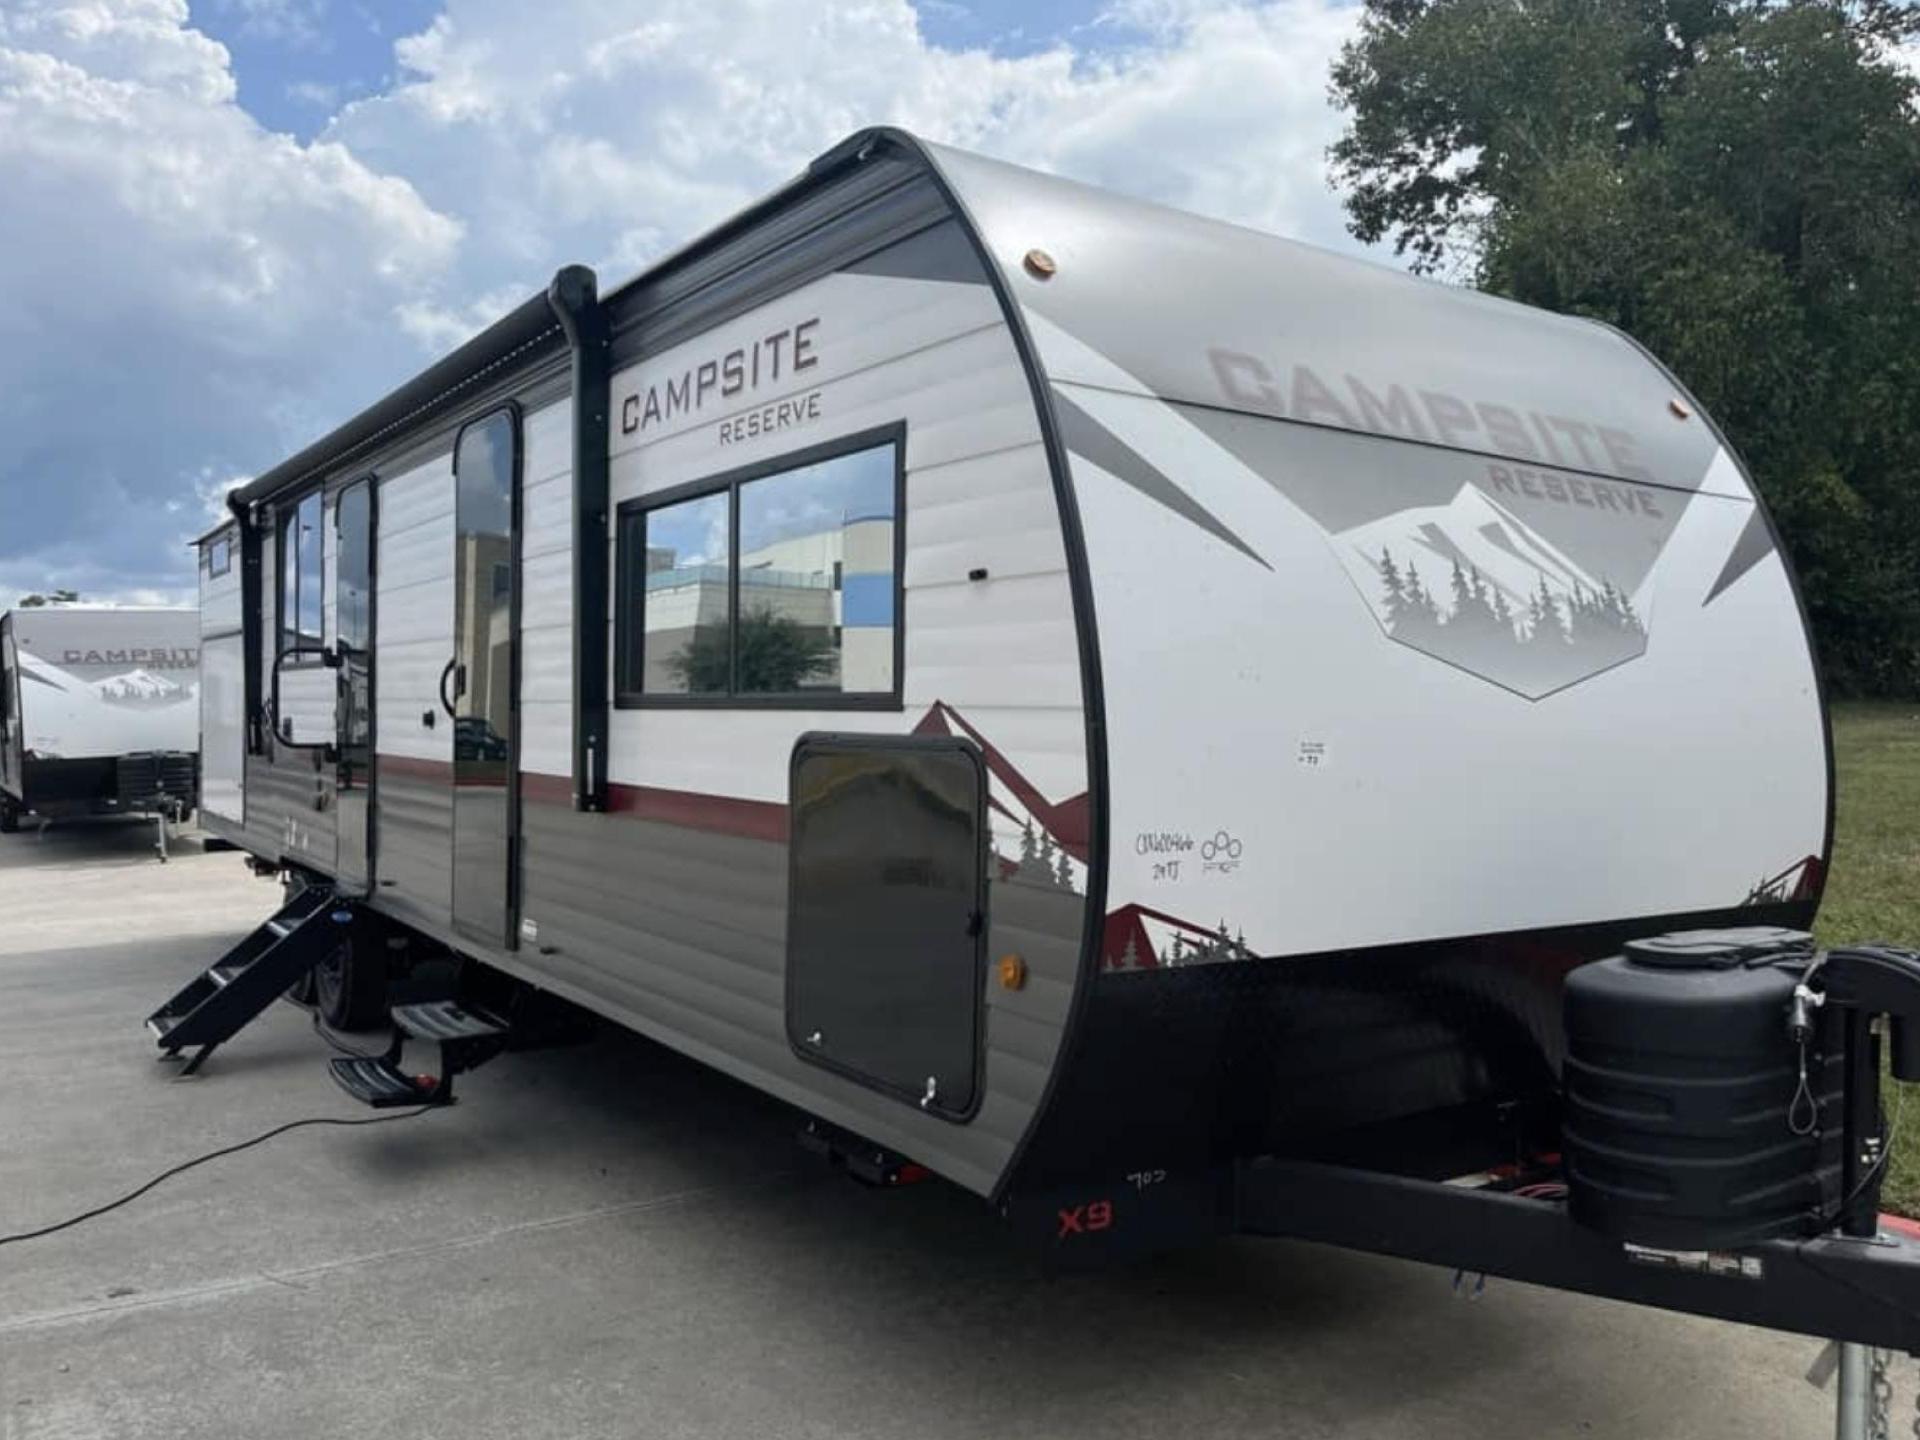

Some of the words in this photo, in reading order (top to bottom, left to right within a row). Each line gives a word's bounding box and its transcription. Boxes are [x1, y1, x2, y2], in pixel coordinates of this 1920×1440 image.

[621, 318, 821, 435] CAMPSITE
[719, 393, 822, 446] RESERVE
[1207, 348, 1654, 484] CAMPSITE
[1486, 464, 1664, 519] RESERVE
[63, 649, 201, 662] CAMPSIT
[1058, 1202, 1112, 1237] X9
